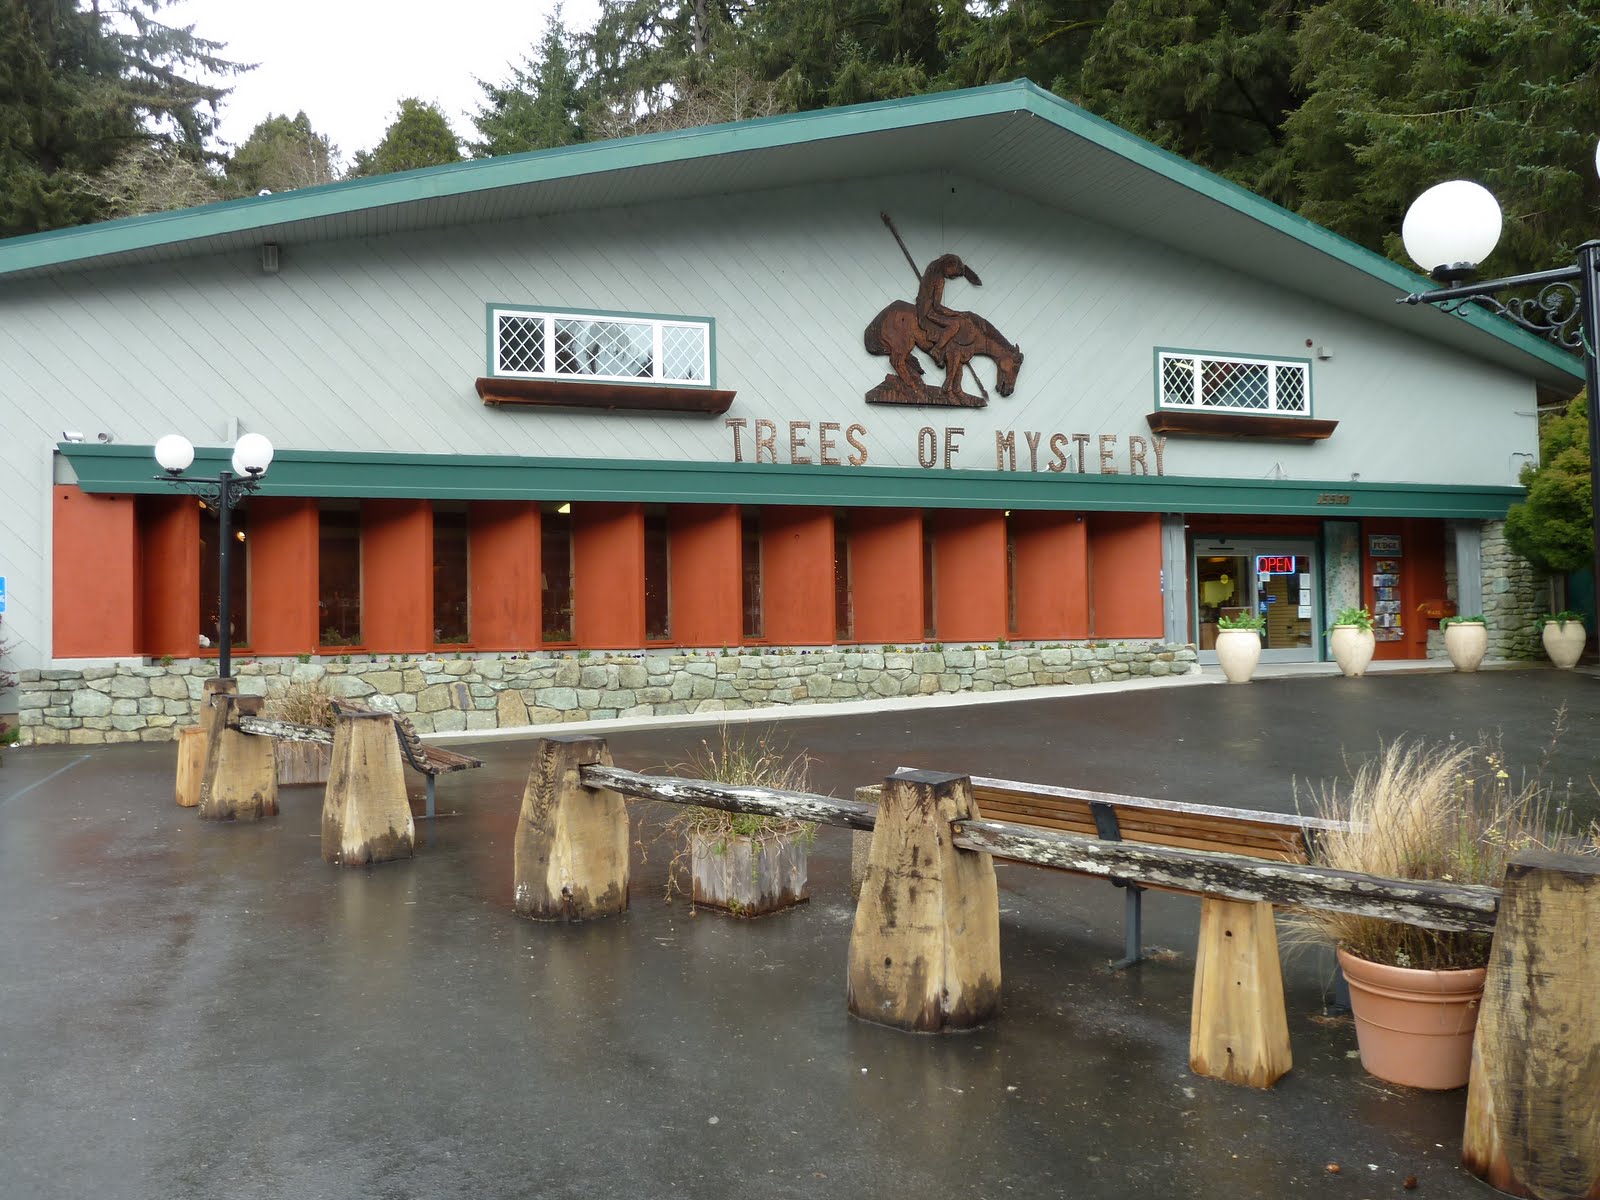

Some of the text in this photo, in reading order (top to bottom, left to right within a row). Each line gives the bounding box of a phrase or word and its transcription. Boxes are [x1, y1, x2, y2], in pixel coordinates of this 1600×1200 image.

[725, 418, 1167, 476] TREES OF MYSTERY
[1259, 558, 1292, 572] OPEN
